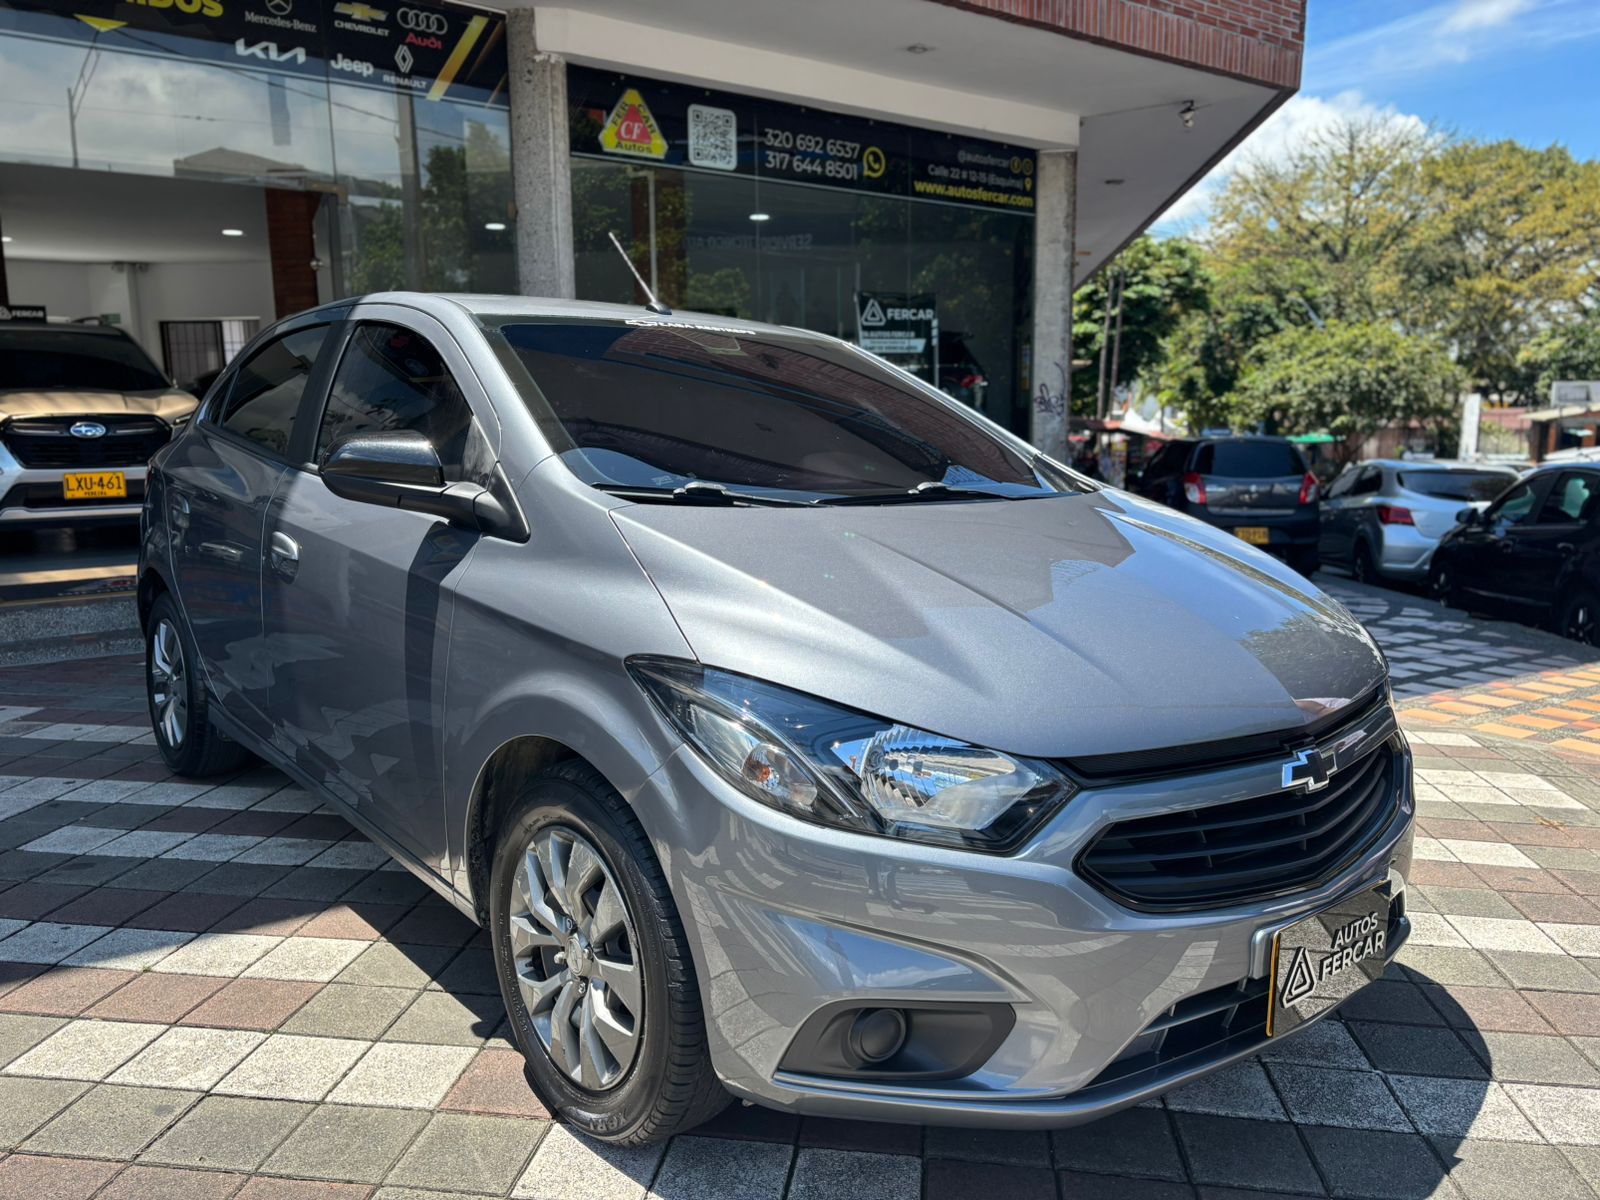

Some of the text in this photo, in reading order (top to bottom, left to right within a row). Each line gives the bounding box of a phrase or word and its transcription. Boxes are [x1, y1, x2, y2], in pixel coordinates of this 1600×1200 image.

[244, 10, 317, 33] Mercedes-Benz
[334, 20, 390, 36] CHEVROLET
[235, 37, 306, 65] KIA
[405, 32, 442, 49] Audi
[330, 53, 374, 77] Jeep
[383, 74, 427, 89] RENAULT
[612, 102, 629, 127] FER
[637, 103, 656, 134] CAR
[620, 121, 644, 139] CF
[616, 142, 653, 154] Autos
[764, 128, 860, 159] 320 692 6537
[765, 151, 858, 180] 317 644 8501
[927, 164, 949, 177] Calle
[950, 167, 960, 179] 22
[913, 180, 1034, 207] www.autosfercar.com
[886, 308, 934, 320] FERCAR
[1330, 911, 1379, 950] AUTOS
[1319, 930, 1385, 982] FERCAR
